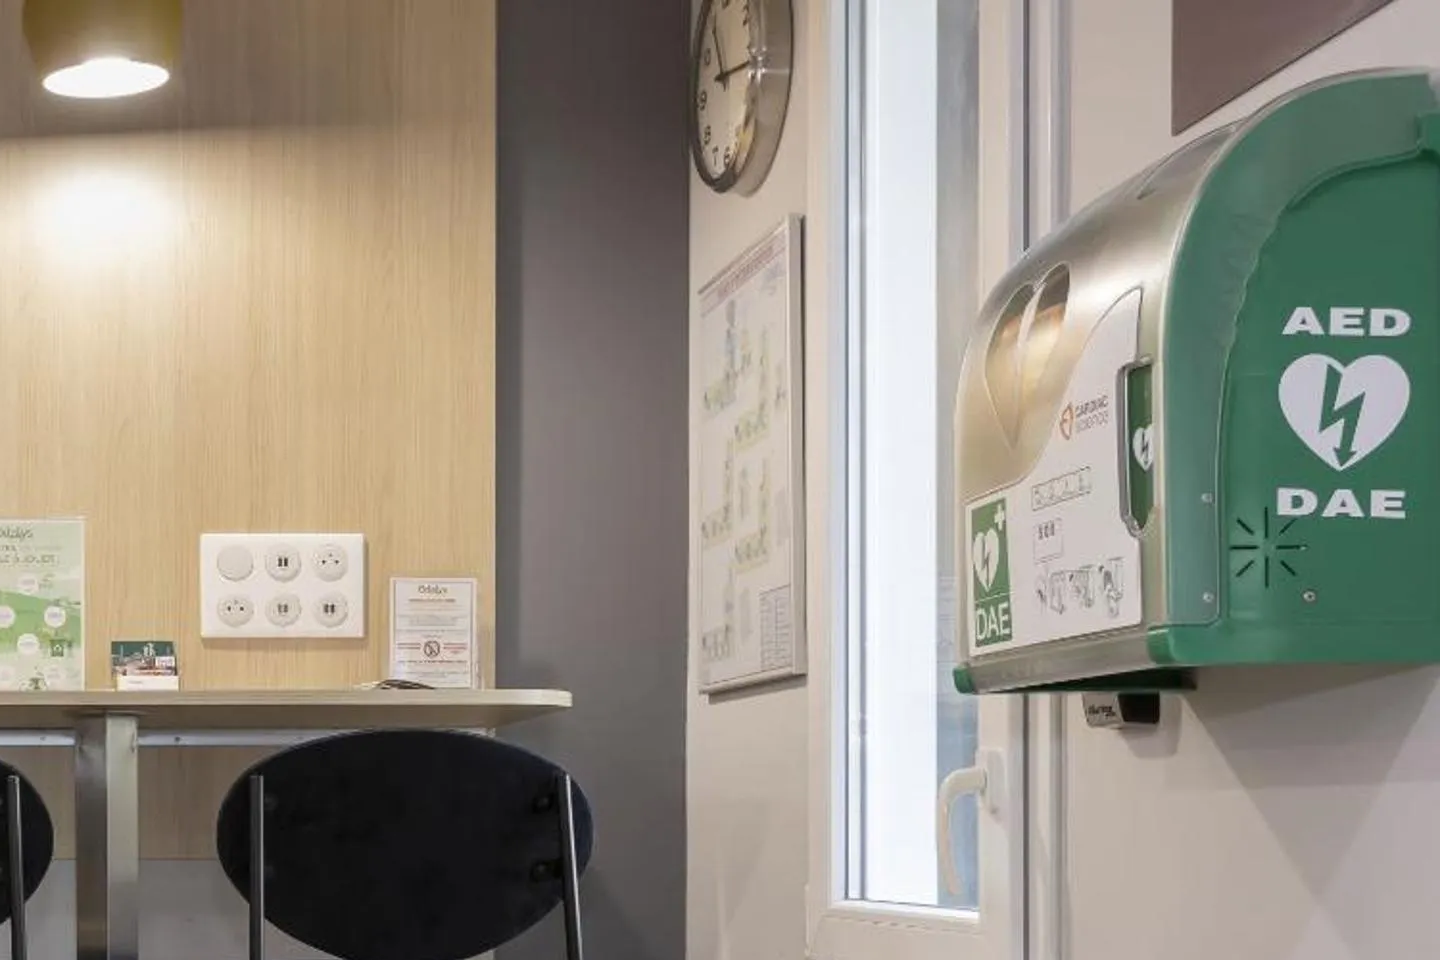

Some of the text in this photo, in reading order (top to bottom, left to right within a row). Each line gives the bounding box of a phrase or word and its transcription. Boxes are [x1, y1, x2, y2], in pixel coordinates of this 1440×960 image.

[1282, 306, 1412, 337] AED
[1276, 487, 1407, 519] DAE
[976, 602, 1011, 641] DAE
